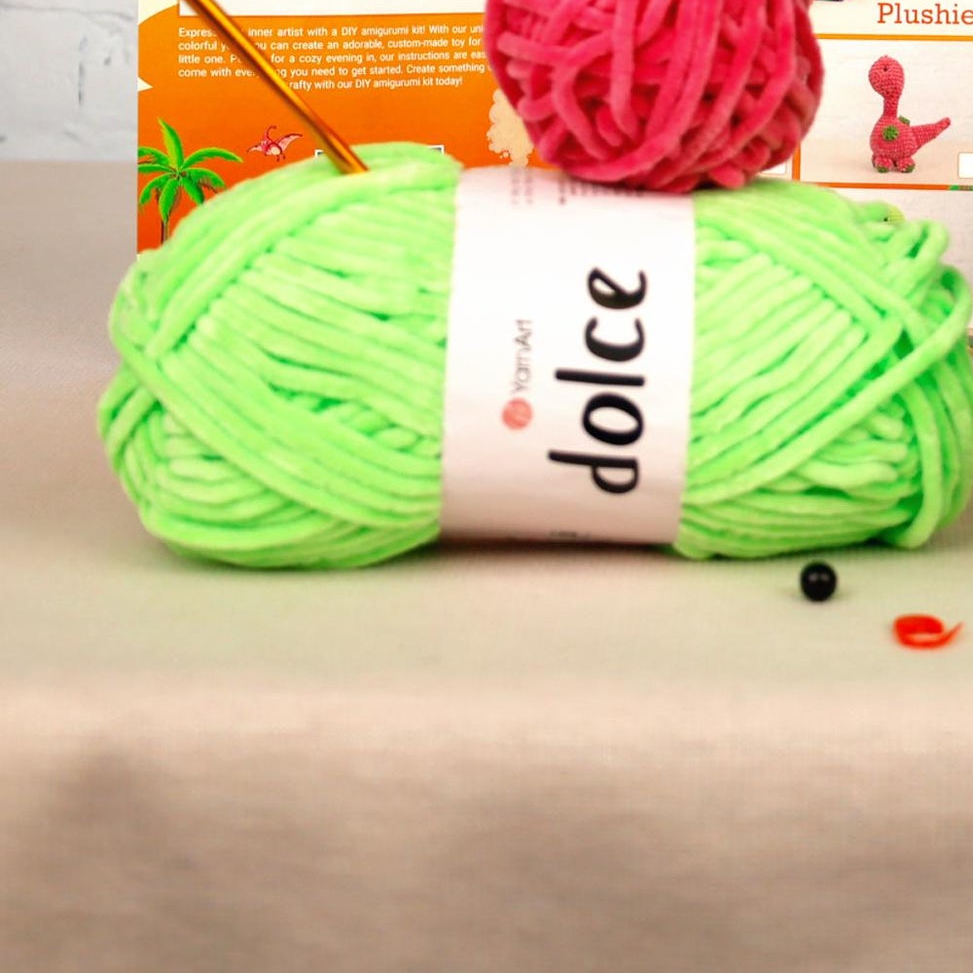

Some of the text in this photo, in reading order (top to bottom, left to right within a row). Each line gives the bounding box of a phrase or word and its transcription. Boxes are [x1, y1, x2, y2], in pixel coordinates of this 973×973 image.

[277, 27, 304, 37] artist
[307, 27, 329, 36] with
[331, 28, 338, 37] a
[341, 26, 358, 36] DIY
[361, 26, 409, 39] amigurumi
[428, 25, 449, 35] With
[452, 26, 467, 34] our
[470, 25, 484, 34] uni
[178, 41, 218, 51] colorful
[270, 42, 289, 50] can
[292, 41, 324, 50] create
[327, 40, 339, 49] an
[342, 38, 385, 49] adorable,
[387, 37, 449, 48] custom-made
[452, 37, 465, 47] toy
[469, 37, 481, 46] for
[178, 53, 201, 64] little
[204, 55, 227, 64] one.
[271, 53, 285, 63] for
[289, 54, 296, 63] a
[299, 54, 322, 65] cozy
[325, 53, 363, 64] evening
[380, 53, 395, 62] our
[398, 51, 450, 61] instructions
[453, 51, 468, 60] are
[471, 50, 487, 60] eas
[178, 68, 208, 77] come
[210, 67, 232, 77] with
[291, 68, 308, 78] you
[311, 66, 335, 76] need
[338, 66, 349, 76] to
[351, 67, 367, 77] get
[406, 63, 436, 74] Create
[438, 62, 485, 74] something
[289, 80, 312, 91] rafty
[314, 79, 335, 89] with
[337, 80, 353, 89] our
[355, 78, 371, 88] DIY
[373, 77, 420, 89] amigurumi
[422, 76, 434, 86] kit
[511, 319, 533, 394] YarnArt
[547, 267, 647, 494] dolce
